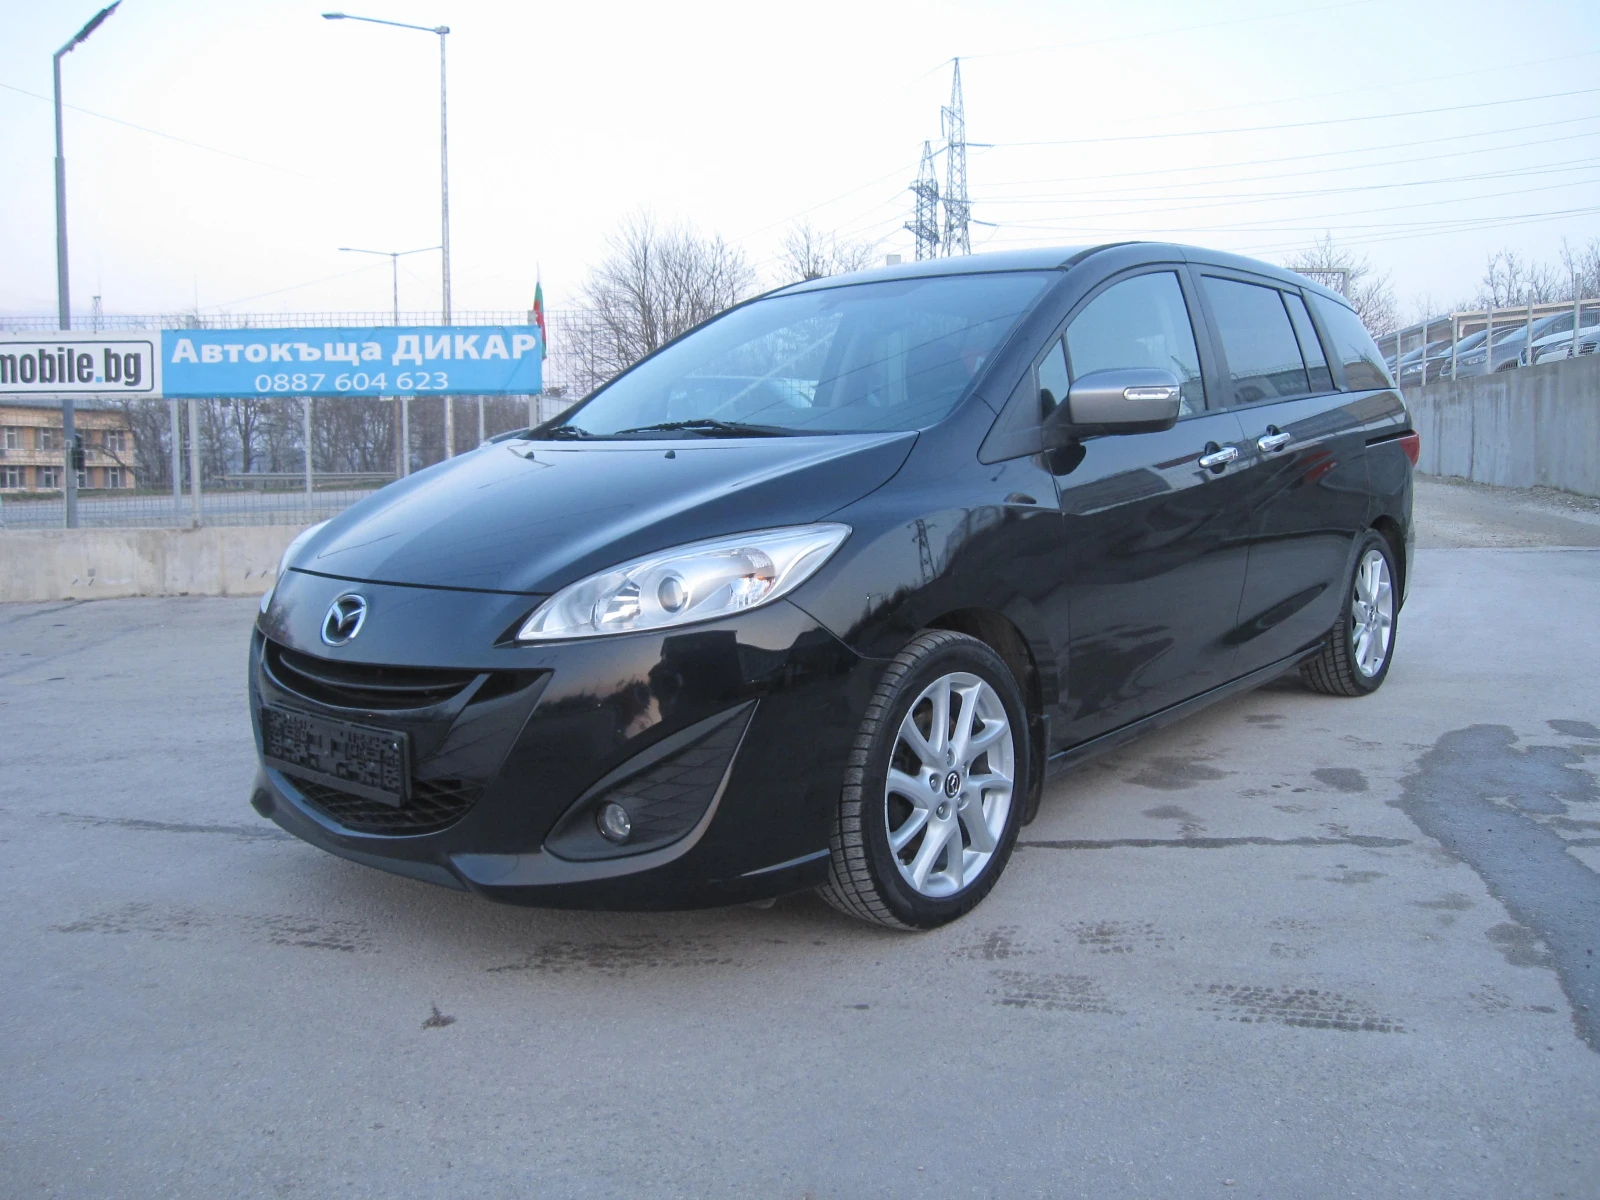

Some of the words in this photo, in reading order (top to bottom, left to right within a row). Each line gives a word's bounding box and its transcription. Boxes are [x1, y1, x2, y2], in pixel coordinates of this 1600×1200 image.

[171, 338, 382, 366] Автокъща
[392, 334, 537, 366] ДИКАР
[255, 373, 326, 392] 0887
[334, 372, 388, 391] 604
[396, 371, 449, 390] 623
